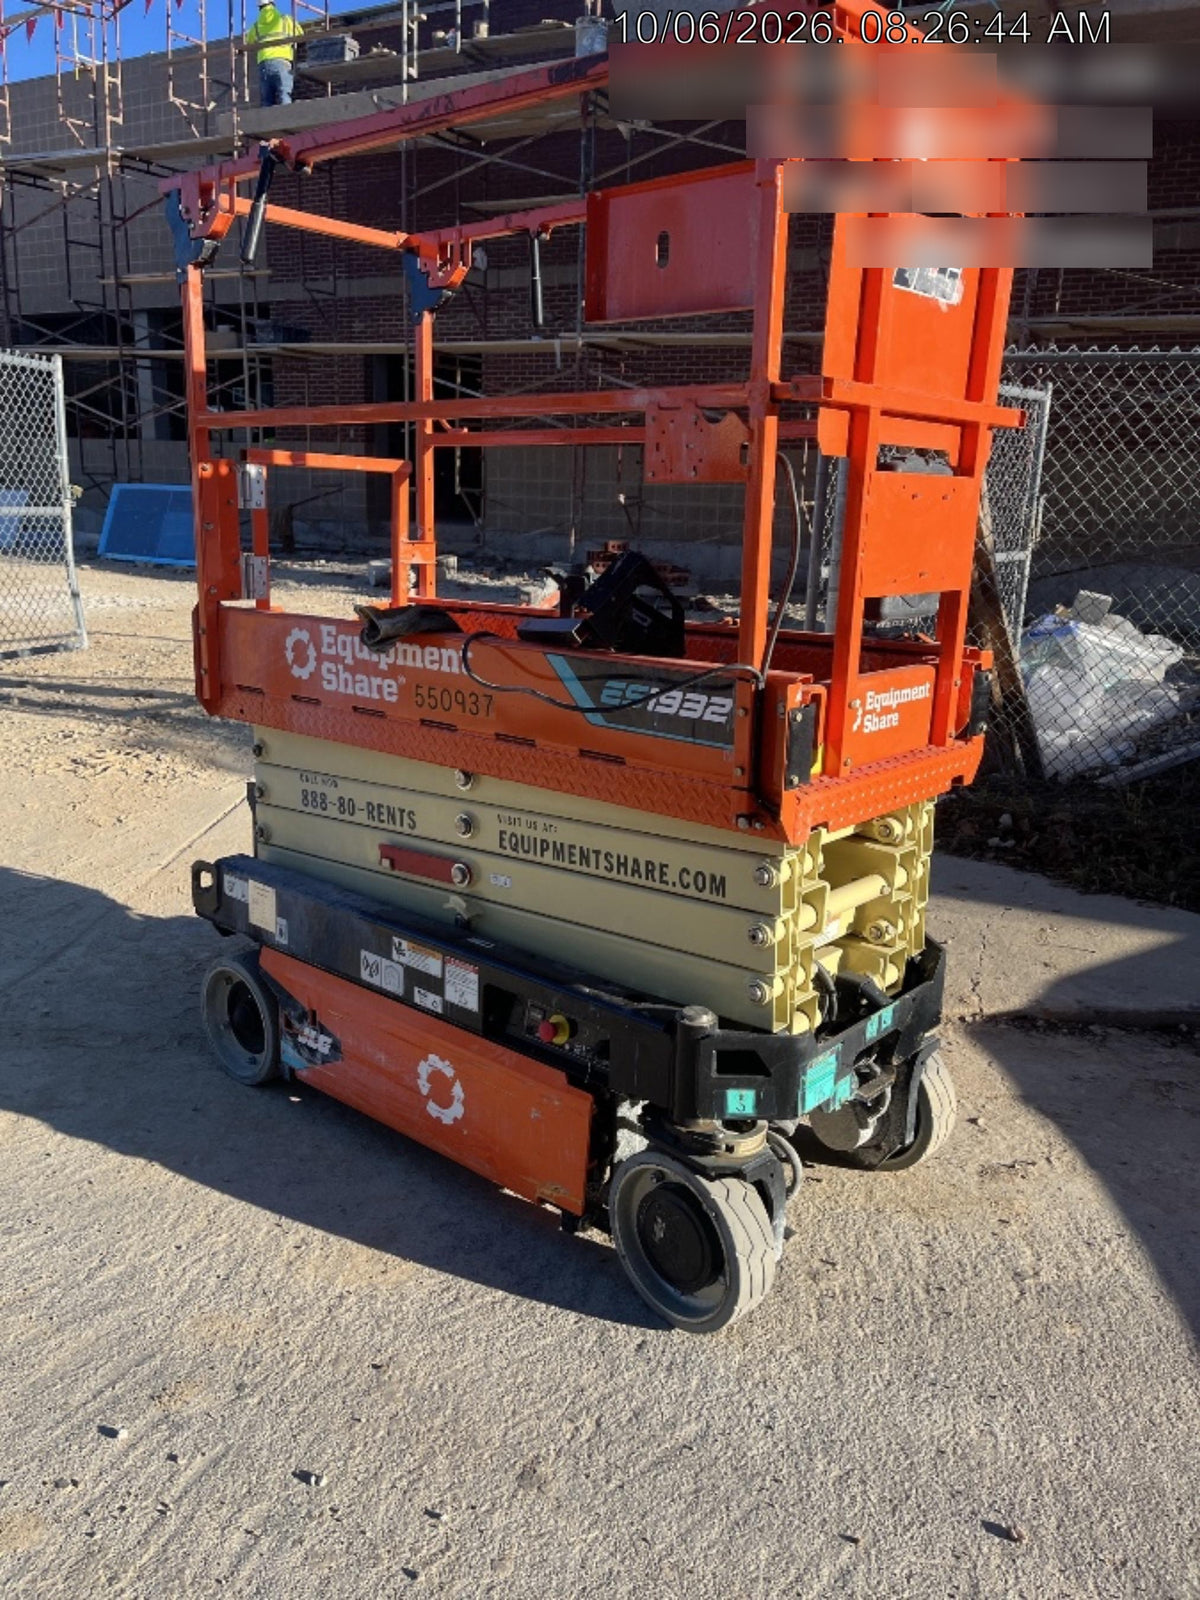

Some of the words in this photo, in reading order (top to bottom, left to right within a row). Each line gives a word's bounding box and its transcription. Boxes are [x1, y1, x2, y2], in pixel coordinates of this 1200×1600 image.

[320, 624, 473, 676] Equpment
[321, 661, 399, 703] Share
[414, 683, 494, 717] 550937
[600, 680, 734, 725] ES1932
[865, 680, 931, 713] Equipment
[862, 712, 900, 734] Share
[301, 788, 417, 831] 888-80-RENTS
[526, 819, 539, 831] US
[498, 829, 727, 899] EQUIPMENTSHARE.COM
